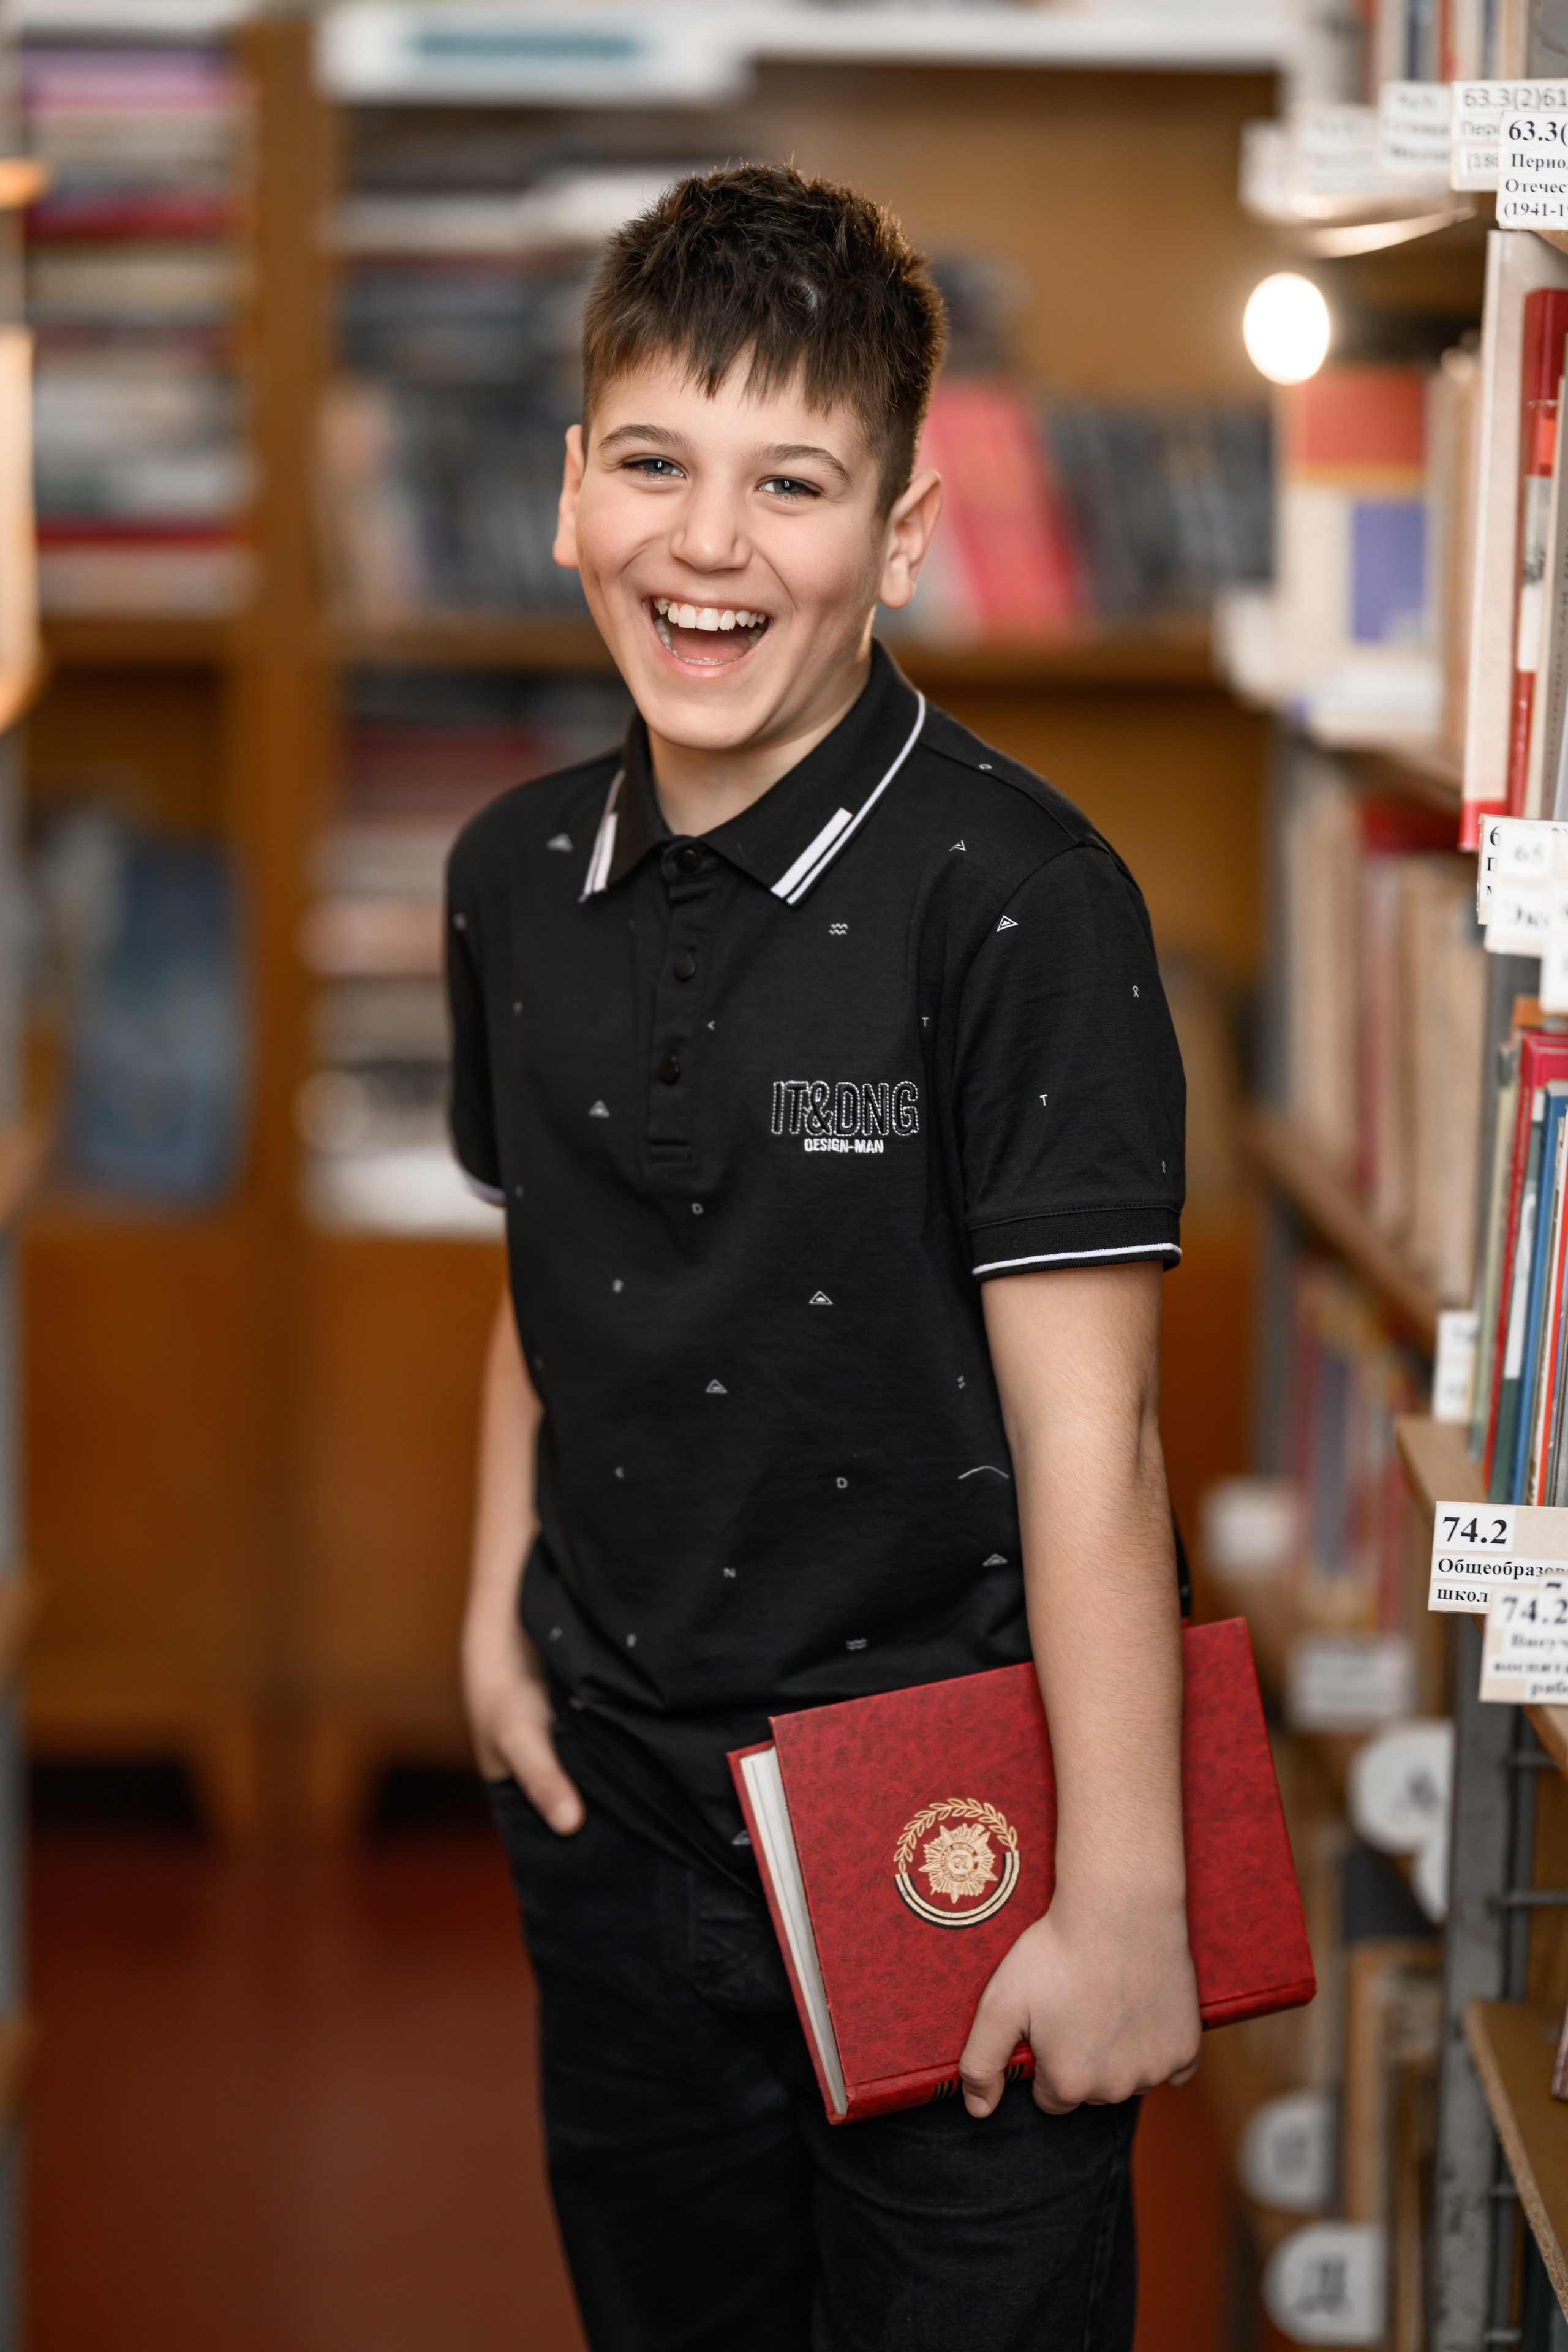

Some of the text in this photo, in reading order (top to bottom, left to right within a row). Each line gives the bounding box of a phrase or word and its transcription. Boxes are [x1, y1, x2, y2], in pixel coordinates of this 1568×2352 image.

[1461, 120, 1500, 141] Пер
[1512, 153, 1568, 172] Перио
[1505, 178, 1568, 193] Отечес
[1504, 202, 1568, 219] (1941-1
[771, 1080, 919, 1136] IT&DNG
[804, 1137, 884, 1154] DESIGN-MAN
[1442, 1516, 1508, 1545] 74.2
[1436, 1588, 1490, 1603] школ
[1503, 1596, 1568, 1624] 74.2
